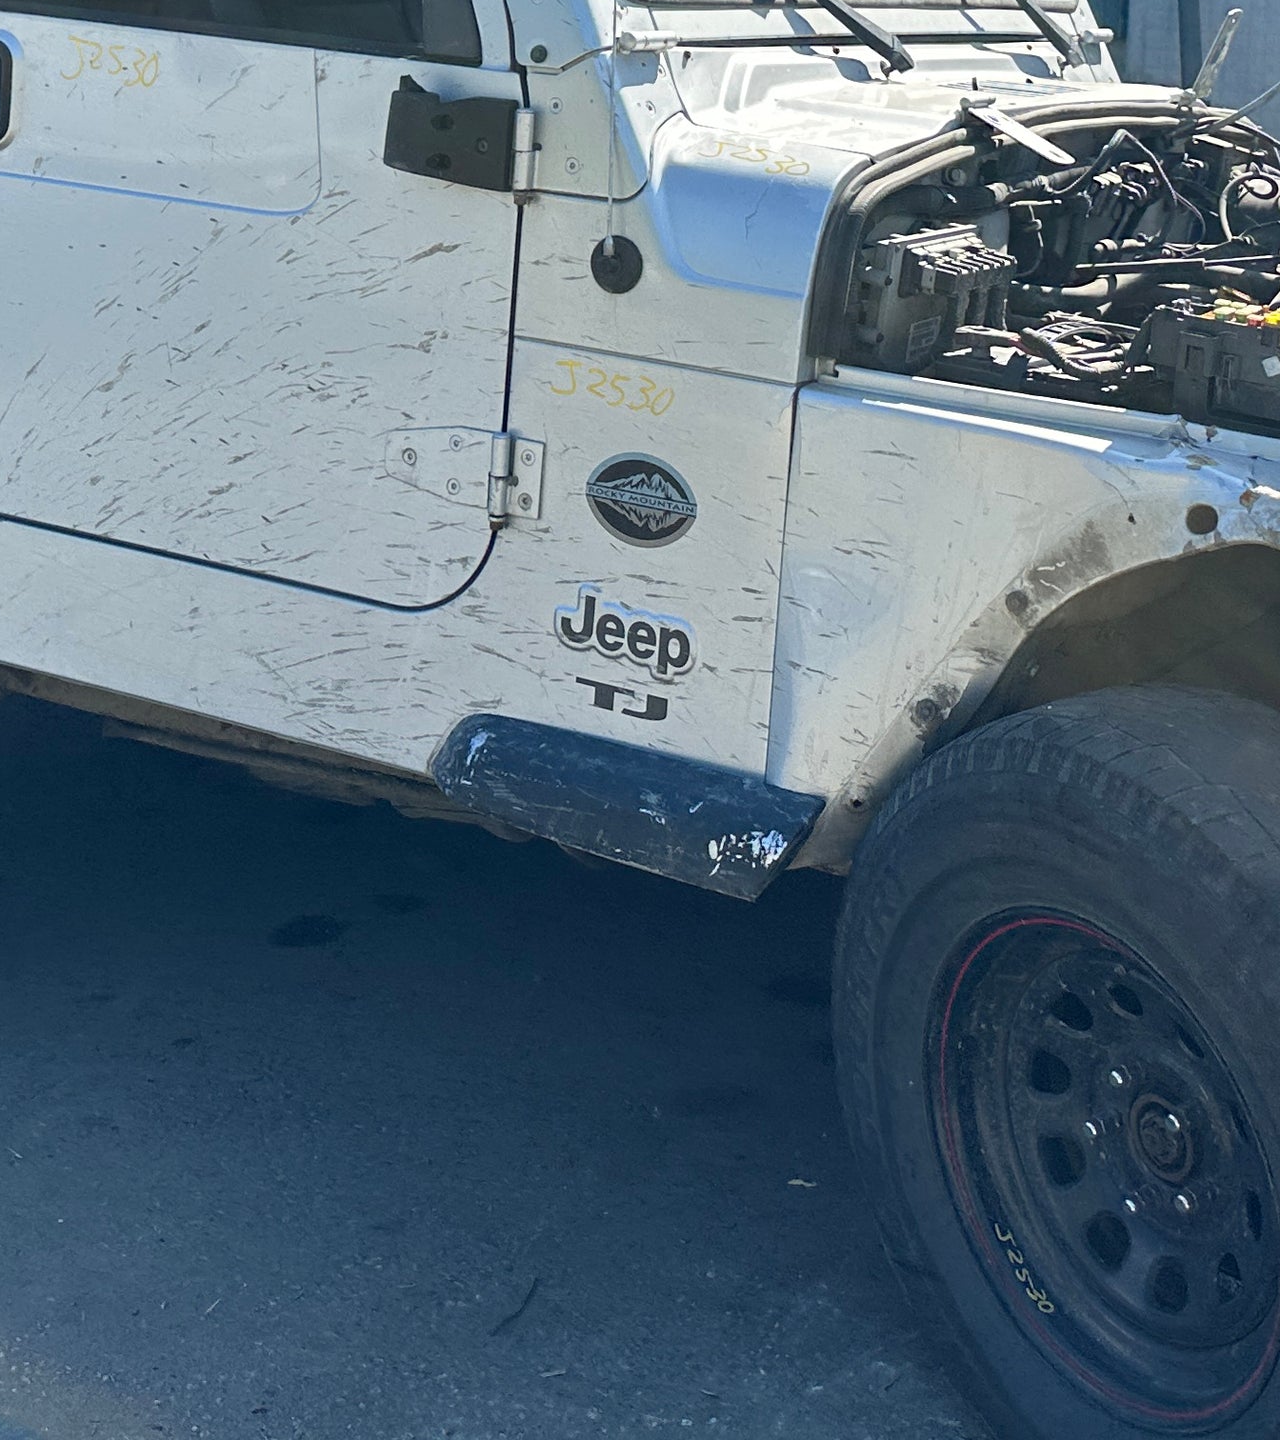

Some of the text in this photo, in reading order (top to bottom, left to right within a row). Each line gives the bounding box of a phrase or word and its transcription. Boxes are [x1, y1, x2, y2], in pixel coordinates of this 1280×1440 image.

[60, 34, 160, 88] J2530
[697, 139, 811, 176] J2530
[550, 360, 676, 417] J2530
[588, 486, 696, 514] ROCKY MOUNTAIN
[560, 594, 692, 676] Jeep
[575, 676, 669, 722] TJ
[993, 1222, 1056, 1314] J2530
